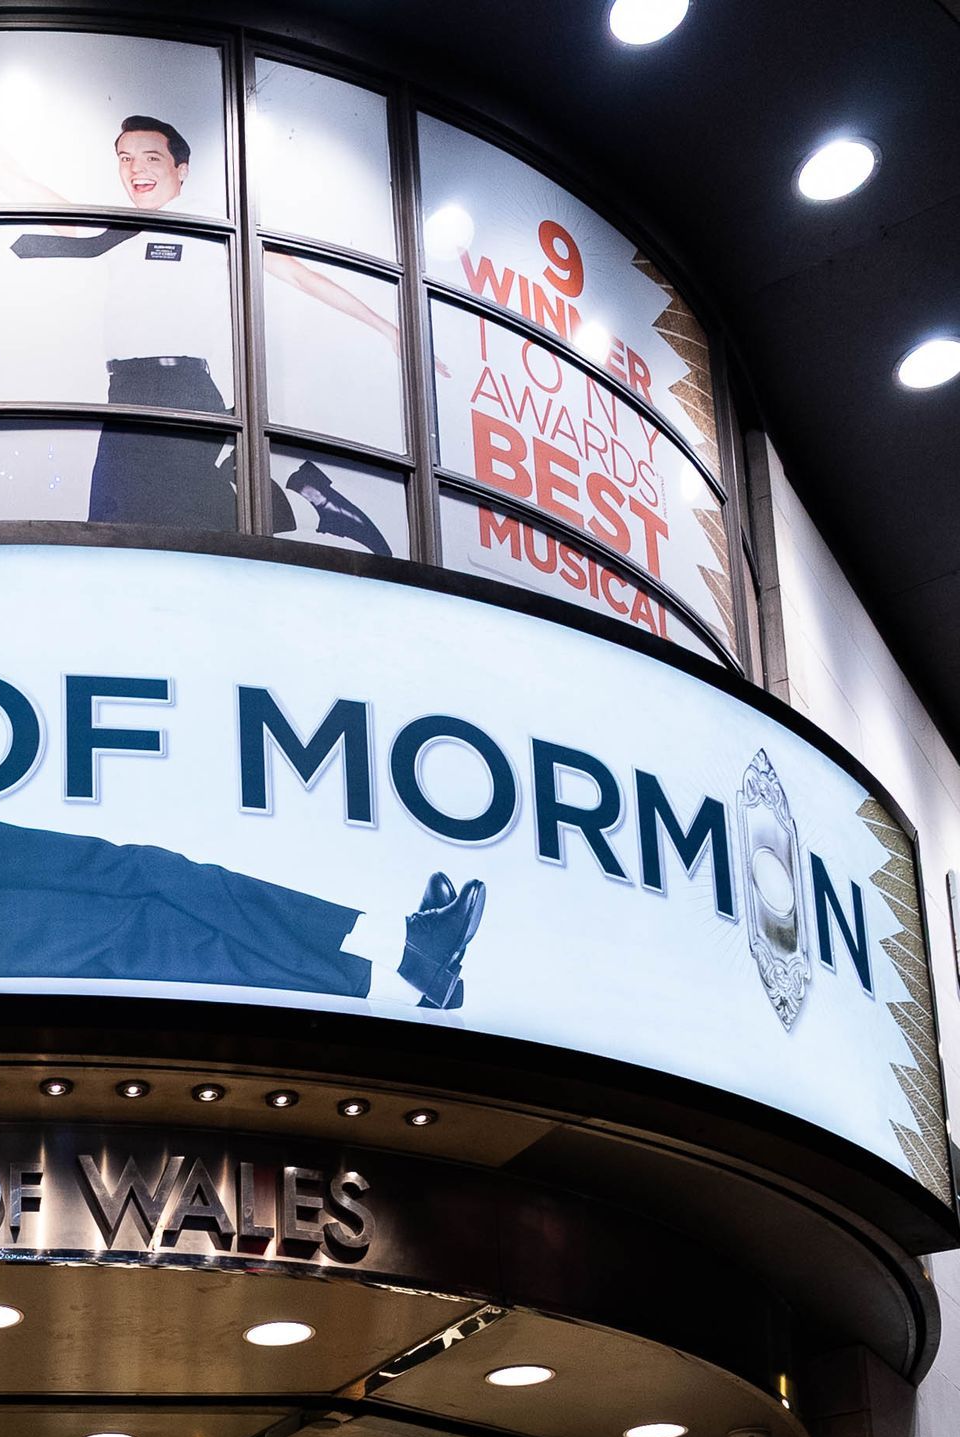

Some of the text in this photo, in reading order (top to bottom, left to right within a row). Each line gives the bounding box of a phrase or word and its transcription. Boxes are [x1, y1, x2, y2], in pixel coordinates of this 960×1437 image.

[538, 219, 584, 299] 9
[470, 367, 658, 507] AWARDS
[471, 408, 669, 581] BEST
[77, 1153, 376, 1257] WALES
